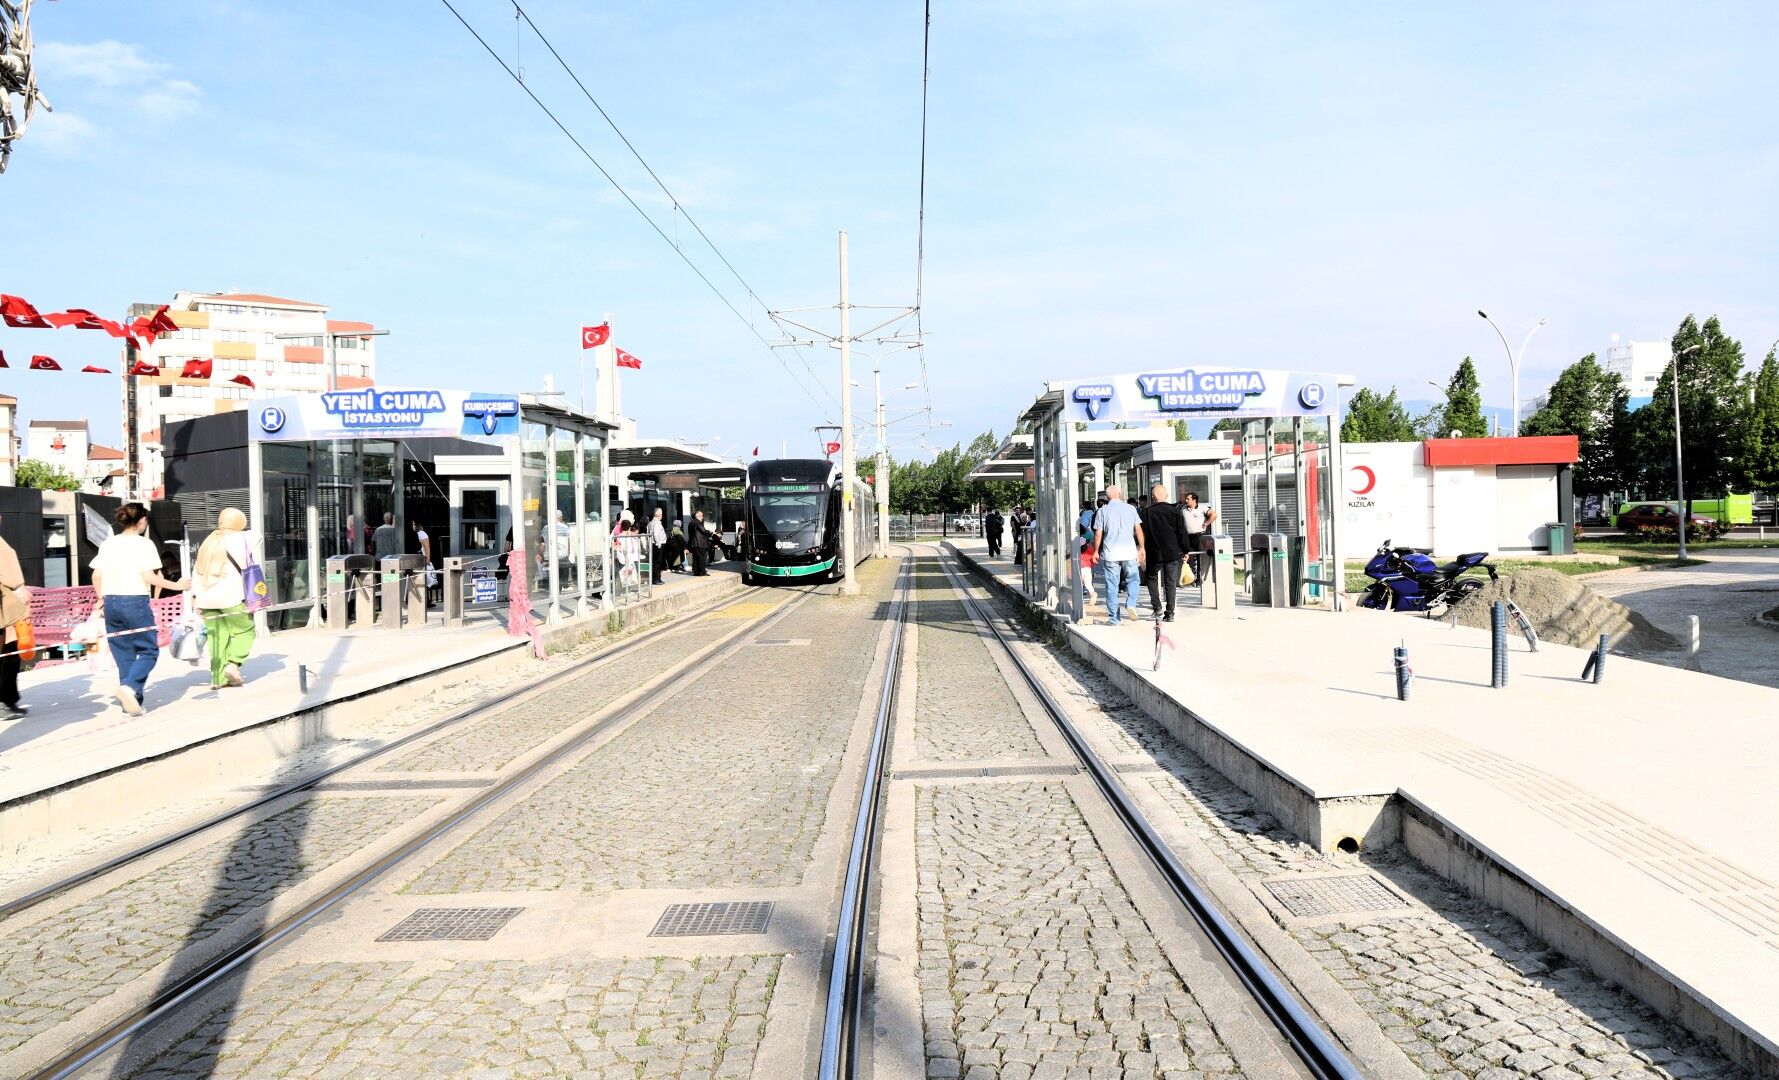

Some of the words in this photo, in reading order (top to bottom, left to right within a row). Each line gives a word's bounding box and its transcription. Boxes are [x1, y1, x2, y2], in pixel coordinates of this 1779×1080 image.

[1142, 373, 1194, 392] YENİ
[1200, 375, 1263, 391] CUMA
[1078, 387, 1112, 396] OTOGAR
[323, 391, 374, 411] YENİ
[380, 394, 443, 410] CUMA
[1164, 393, 1242, 405] İSTASYONU
[464, 402, 515, 412] KURUÇEŞME
[344, 411, 422, 423] İSTASYONU
